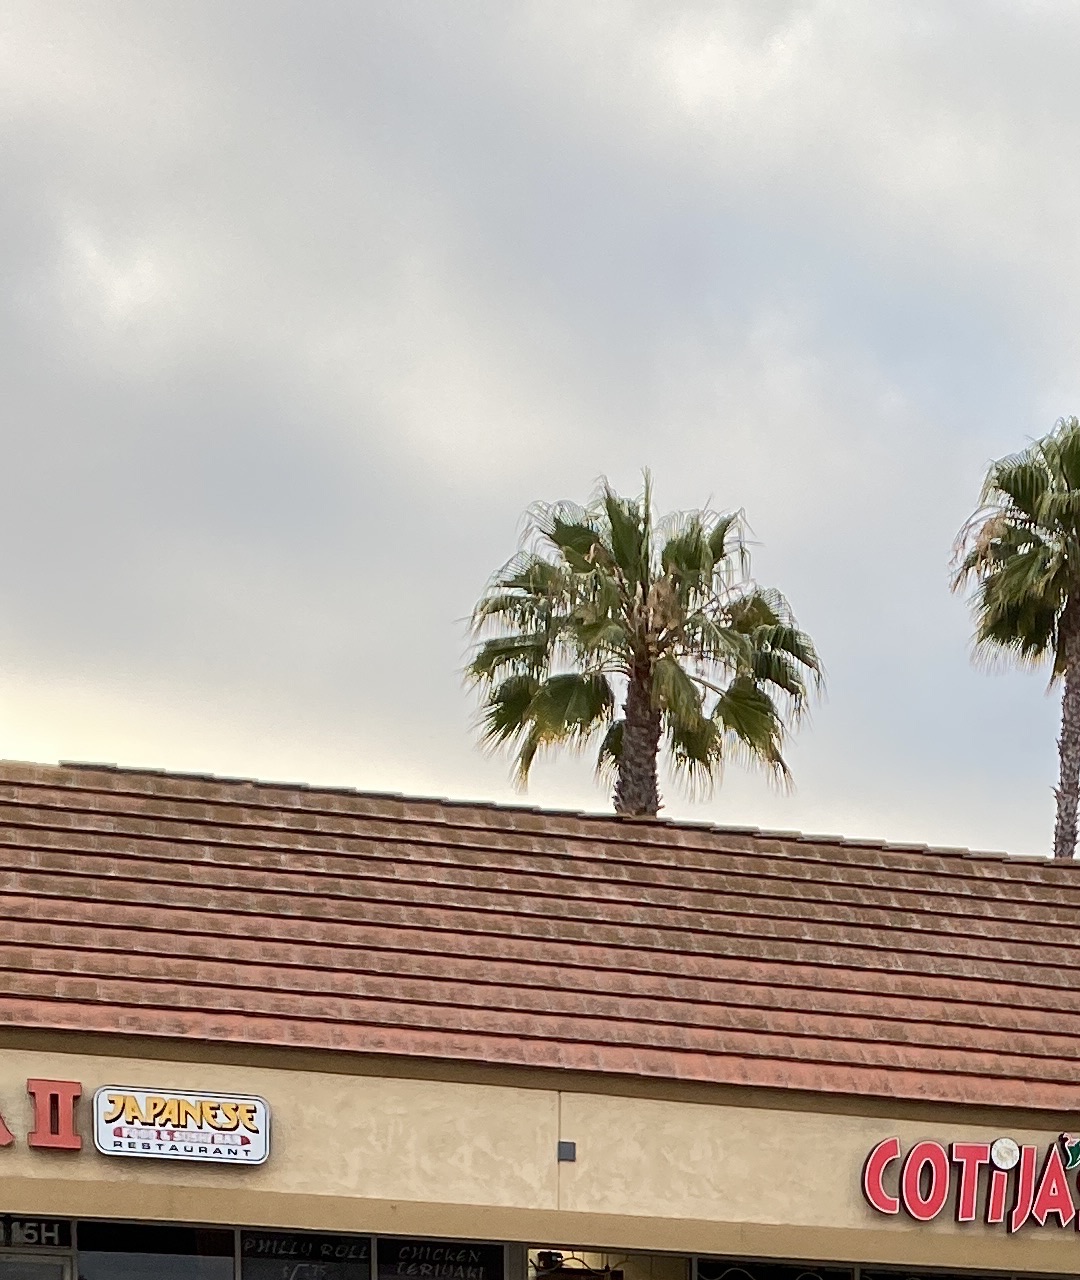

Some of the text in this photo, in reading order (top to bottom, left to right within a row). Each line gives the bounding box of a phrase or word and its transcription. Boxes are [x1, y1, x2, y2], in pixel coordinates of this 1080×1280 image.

[103, 1095, 259, 1134] JAPANESE
[113, 1141, 251, 1157] RESTAURANT
[242, 1238, 369, 1259] PHILLY ROLL
[398, 1246, 482, 1263] CHICKEN
[396, 1261, 484, 1279] TERIYAKI
